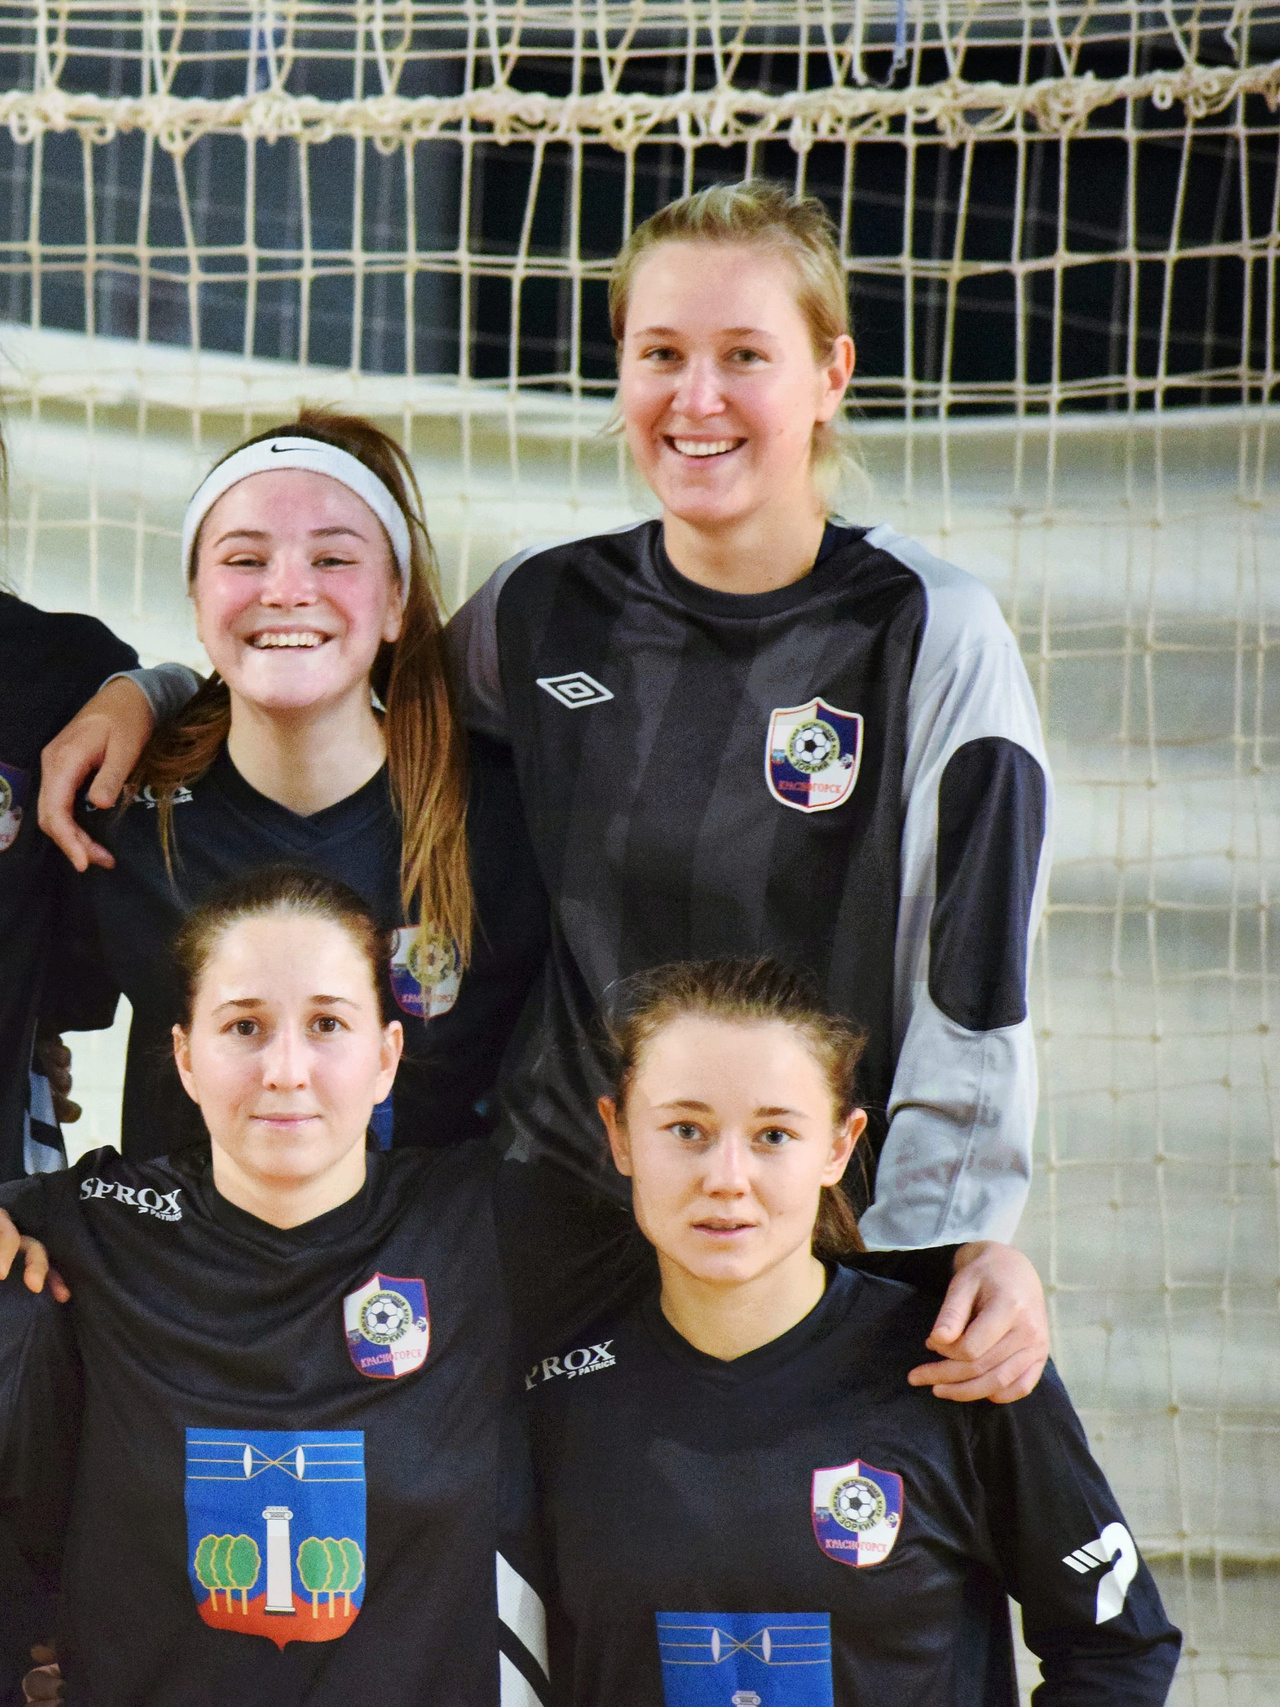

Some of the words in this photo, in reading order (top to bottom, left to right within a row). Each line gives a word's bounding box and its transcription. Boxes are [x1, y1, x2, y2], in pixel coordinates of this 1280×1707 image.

[80, 1177, 182, 1214] SPROX
[370, 1327, 407, 1343] ЗОРКИЙ
[360, 1348, 422, 1368] КРАСНОГОРСК
[524, 1339, 616, 1391] PROX
[578, 1357, 617, 1376] PATRICK
[839, 1517, 876, 1531] ЗОРКИЙ
[825, 1538, 887, 1553] КРАСНОГОРСК
